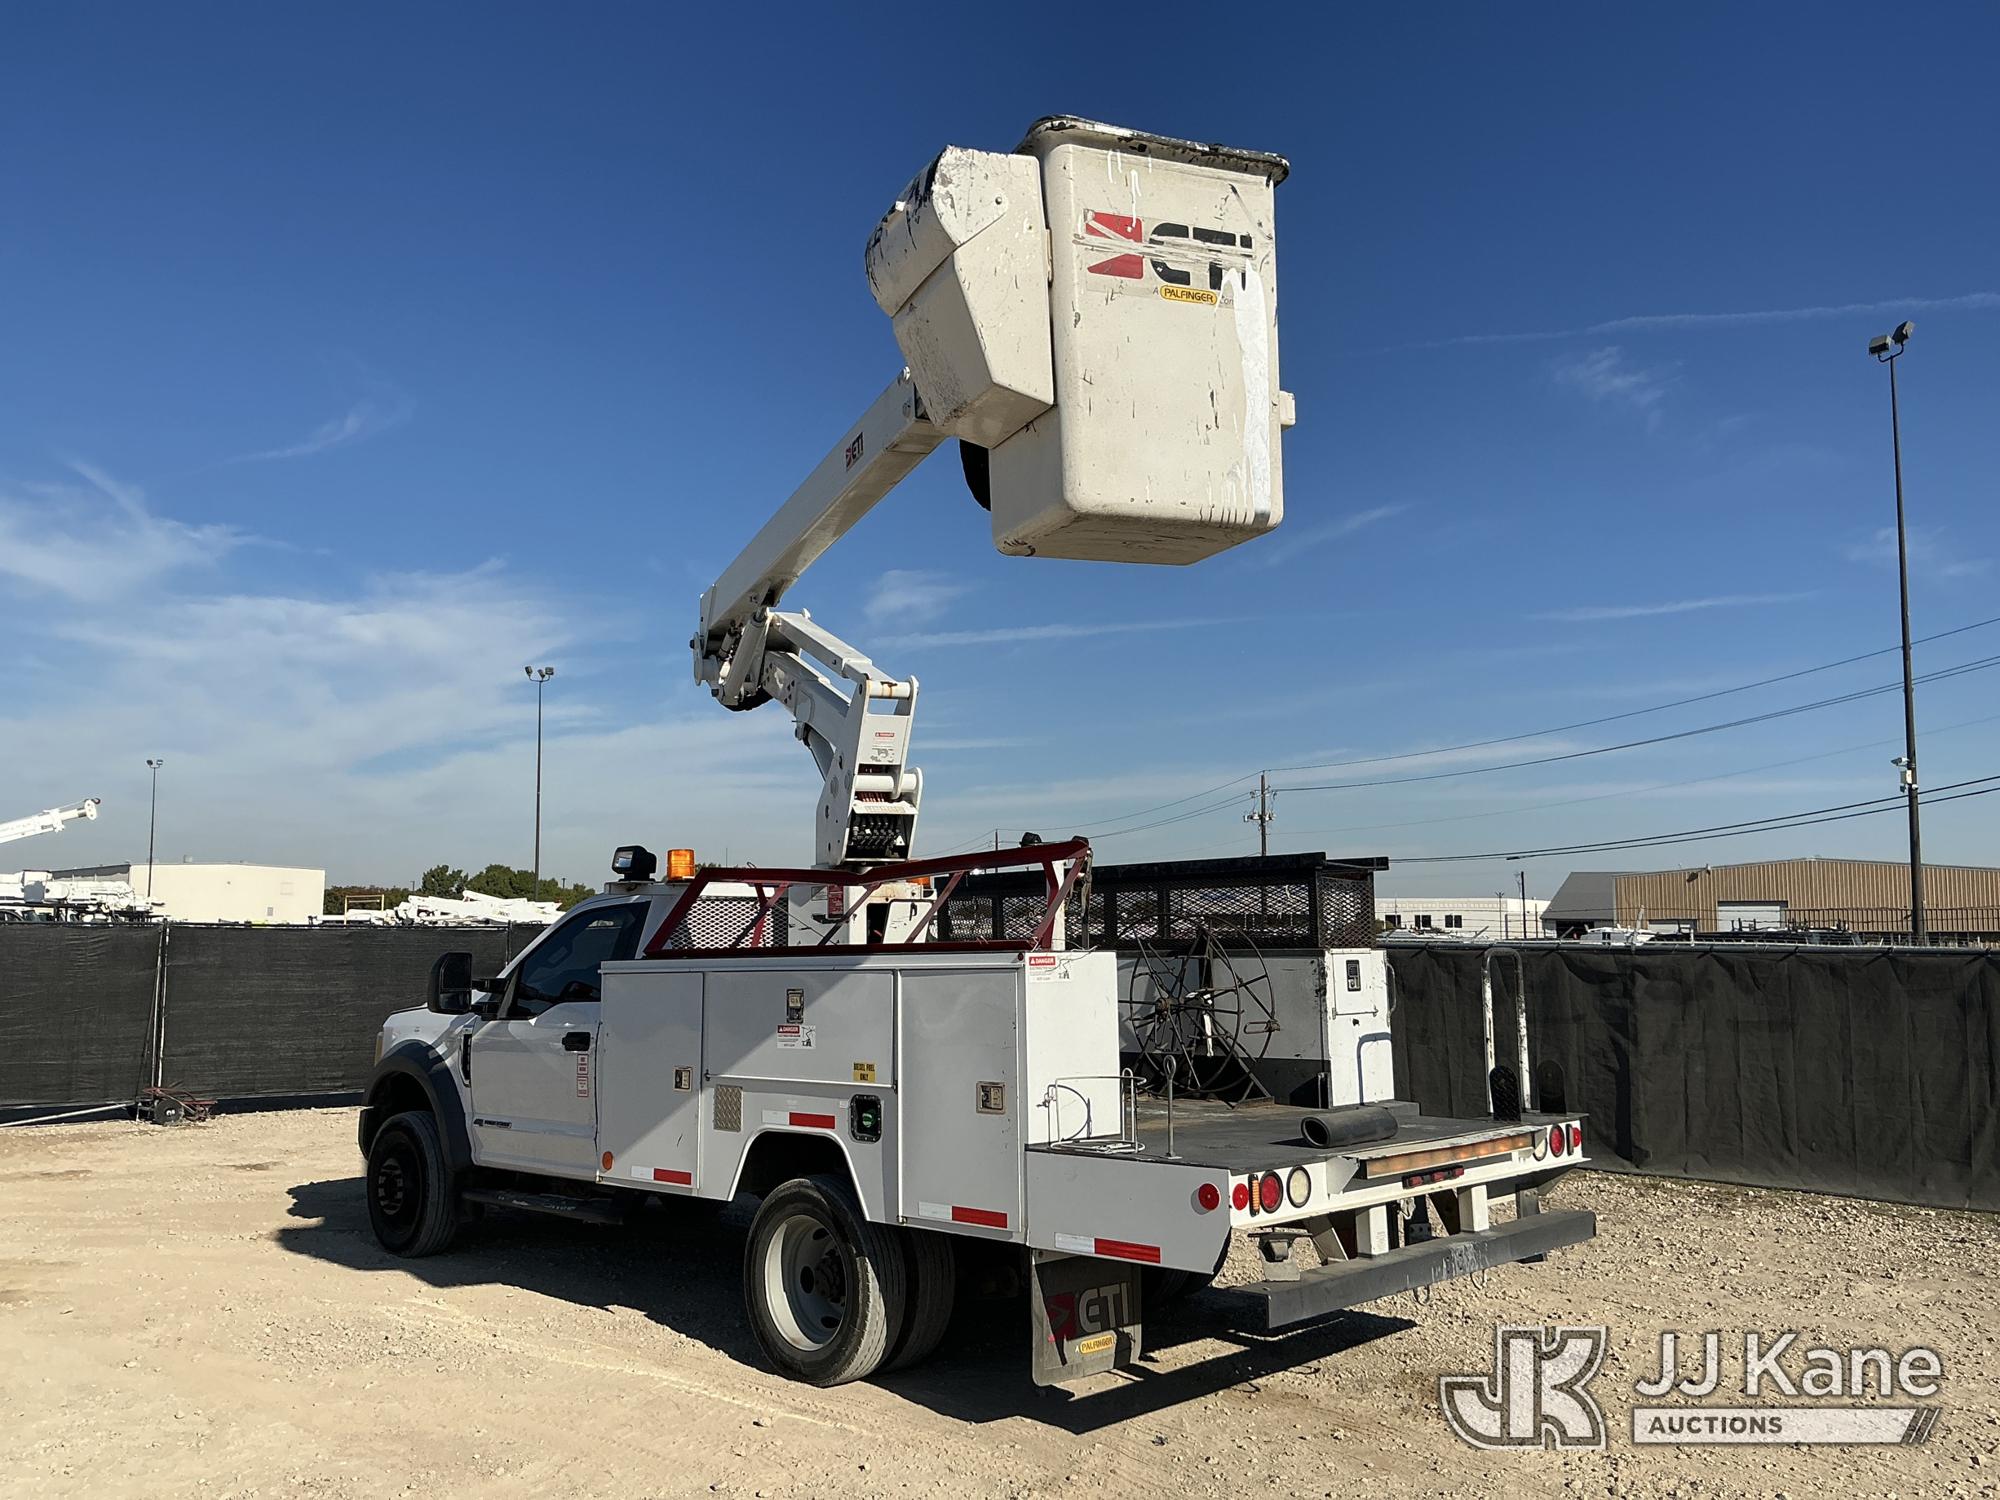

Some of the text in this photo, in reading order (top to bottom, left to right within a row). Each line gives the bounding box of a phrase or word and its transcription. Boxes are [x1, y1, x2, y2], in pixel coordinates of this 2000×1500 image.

[1152, 286, 1159, 295] A
[1164, 287, 1214, 303] PALFINGER
[851, 431, 864, 461] ETI
[1035, 957, 1054, 965] DANGER
[1079, 1282, 1128, 1333] ETI
[1074, 1336, 1113, 1353] A PALFINGER
